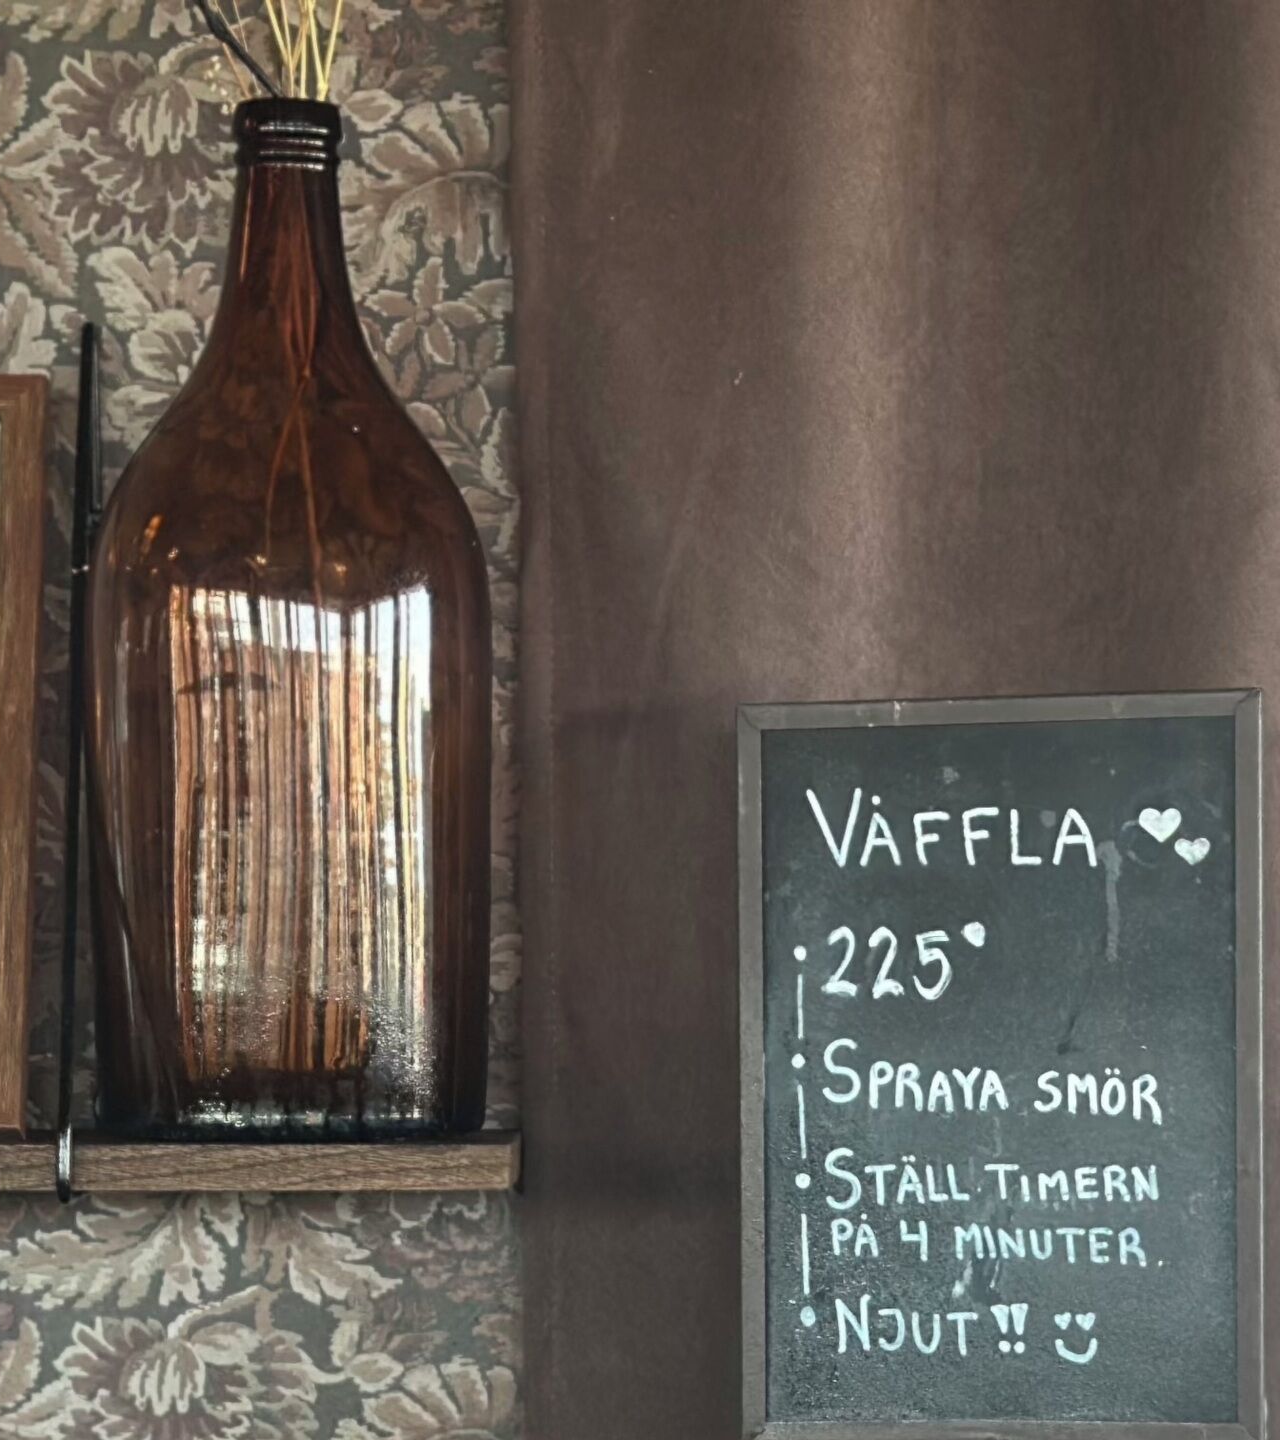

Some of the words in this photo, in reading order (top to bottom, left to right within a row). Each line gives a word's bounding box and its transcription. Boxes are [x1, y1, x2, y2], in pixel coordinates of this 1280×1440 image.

[1034, 1068, 1162, 1126] SMÖR
[831, 1213, 878, 1257] PÅ
[900, 1220, 928, 1260] 4
